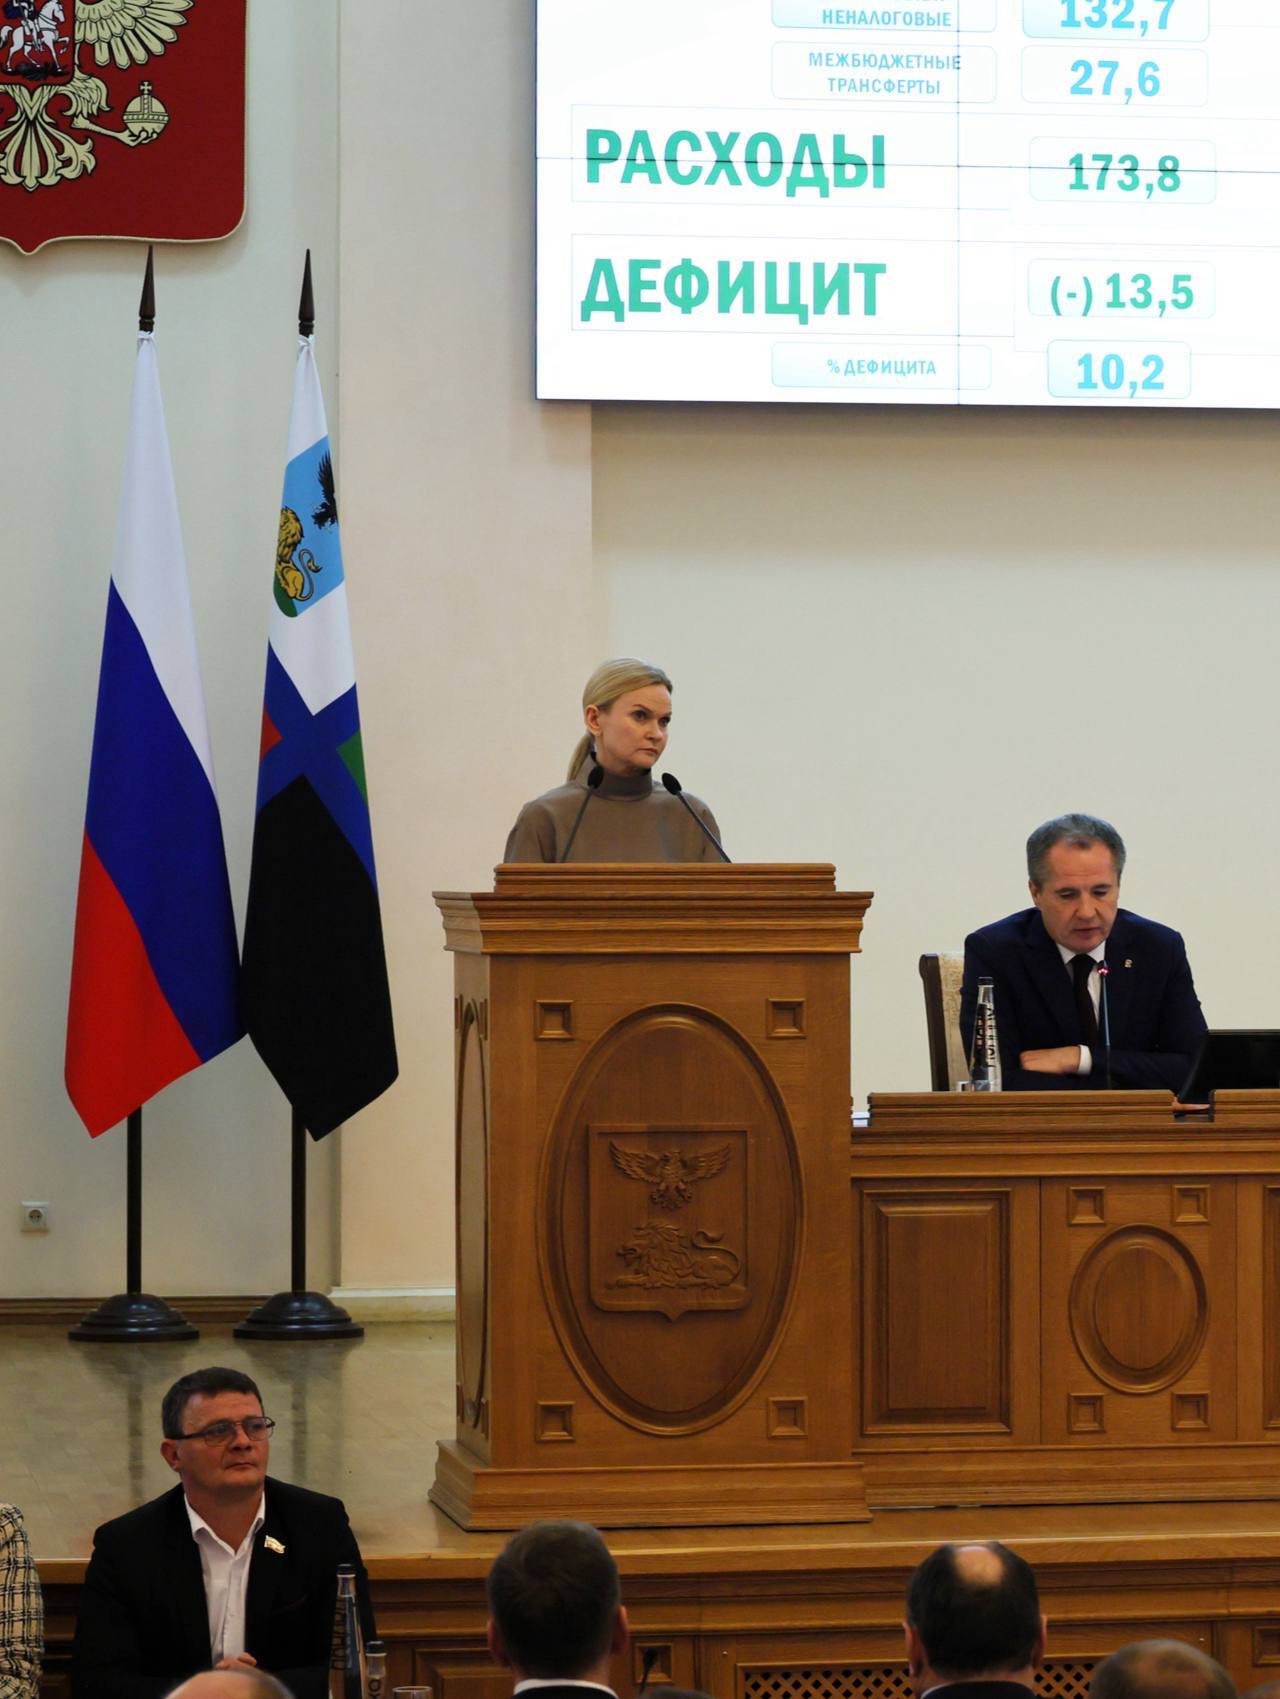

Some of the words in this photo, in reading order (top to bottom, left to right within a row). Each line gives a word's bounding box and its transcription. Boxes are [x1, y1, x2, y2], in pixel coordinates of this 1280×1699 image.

[821, 9, 951, 27] НЕНАЛОГОВЫЕ
[1060, 0, 1174, 37] 132,7
[809, 52, 961, 72] МЕЖБЮДЖЕТНЫЕ
[1070, 59, 1161, 105] 27,6
[829, 77, 941, 95] ТРАНСФЕРТЫ
[586, 128, 885, 198] РАСХОДЫ
[1069, 153, 1181, 198] 173,8
[580, 258, 887, 325] ДЕФИЦИТ
[1077, 353, 1165, 399] 10,2
